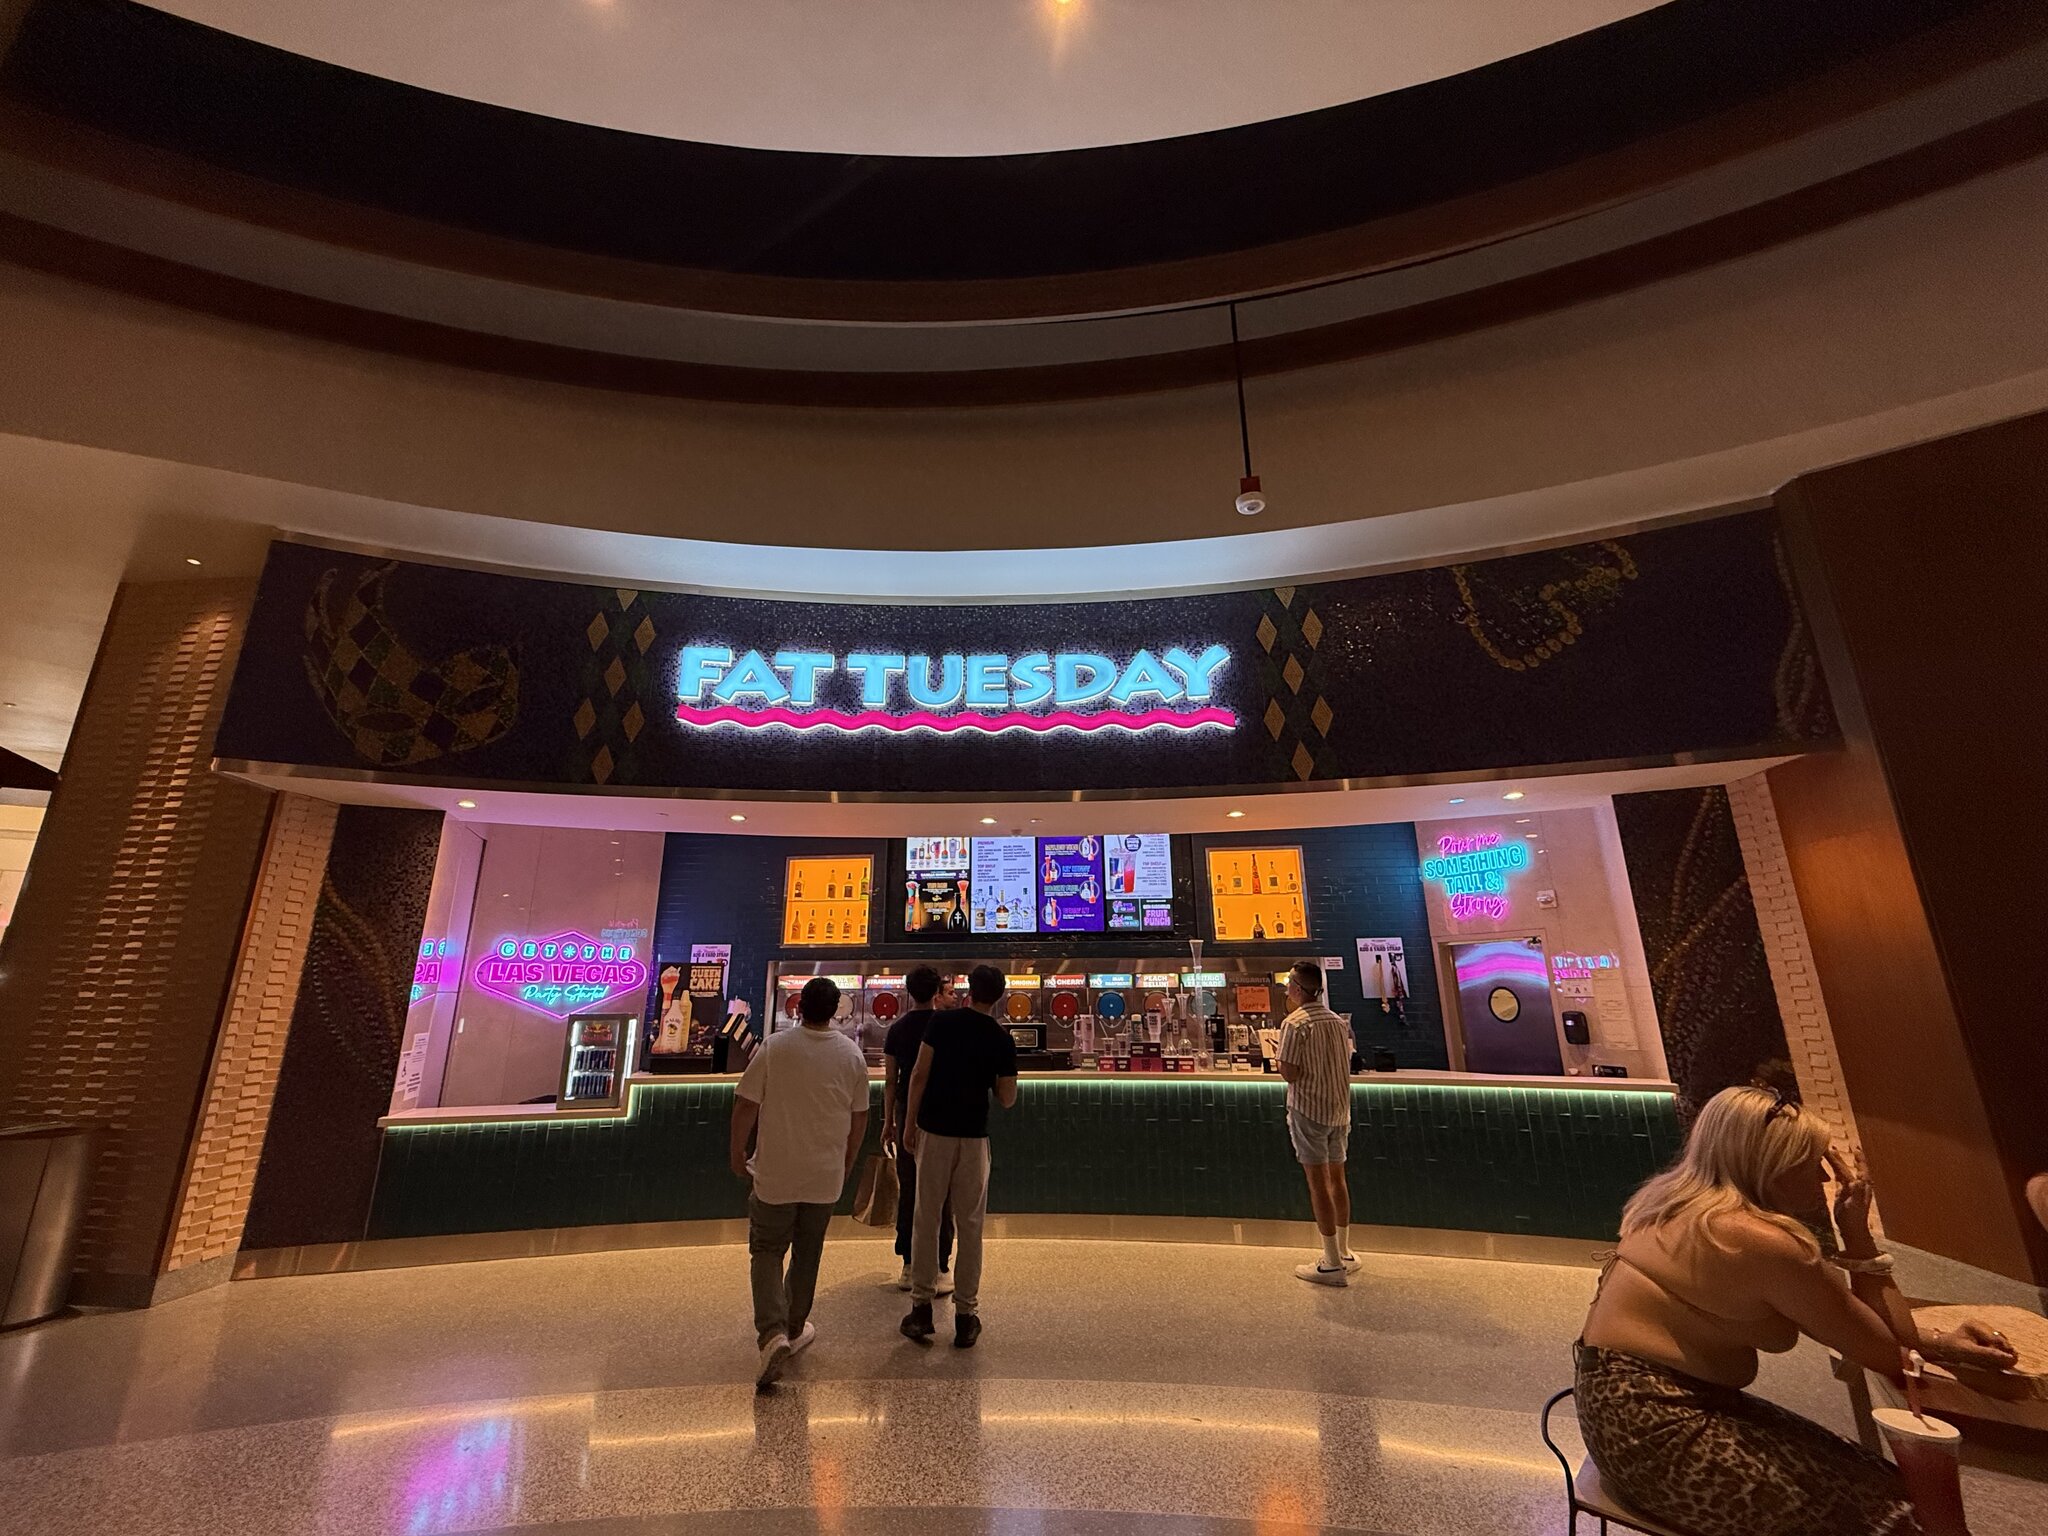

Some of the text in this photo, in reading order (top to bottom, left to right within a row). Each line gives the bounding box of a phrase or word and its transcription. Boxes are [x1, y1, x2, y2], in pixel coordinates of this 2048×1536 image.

[678, 644, 1231, 708] FAT TUESDAY
[1437, 836, 1474, 858] Pour
[1425, 846, 1523, 878] SOMETHING
[1445, 871, 1502, 895] TALL &
[1450, 892, 1507, 918] Strong
[500, 941, 633, 960] GET THE
[488, 962, 636, 984] LAS VEGAS
[523, 984, 610, 1004] Party Started
